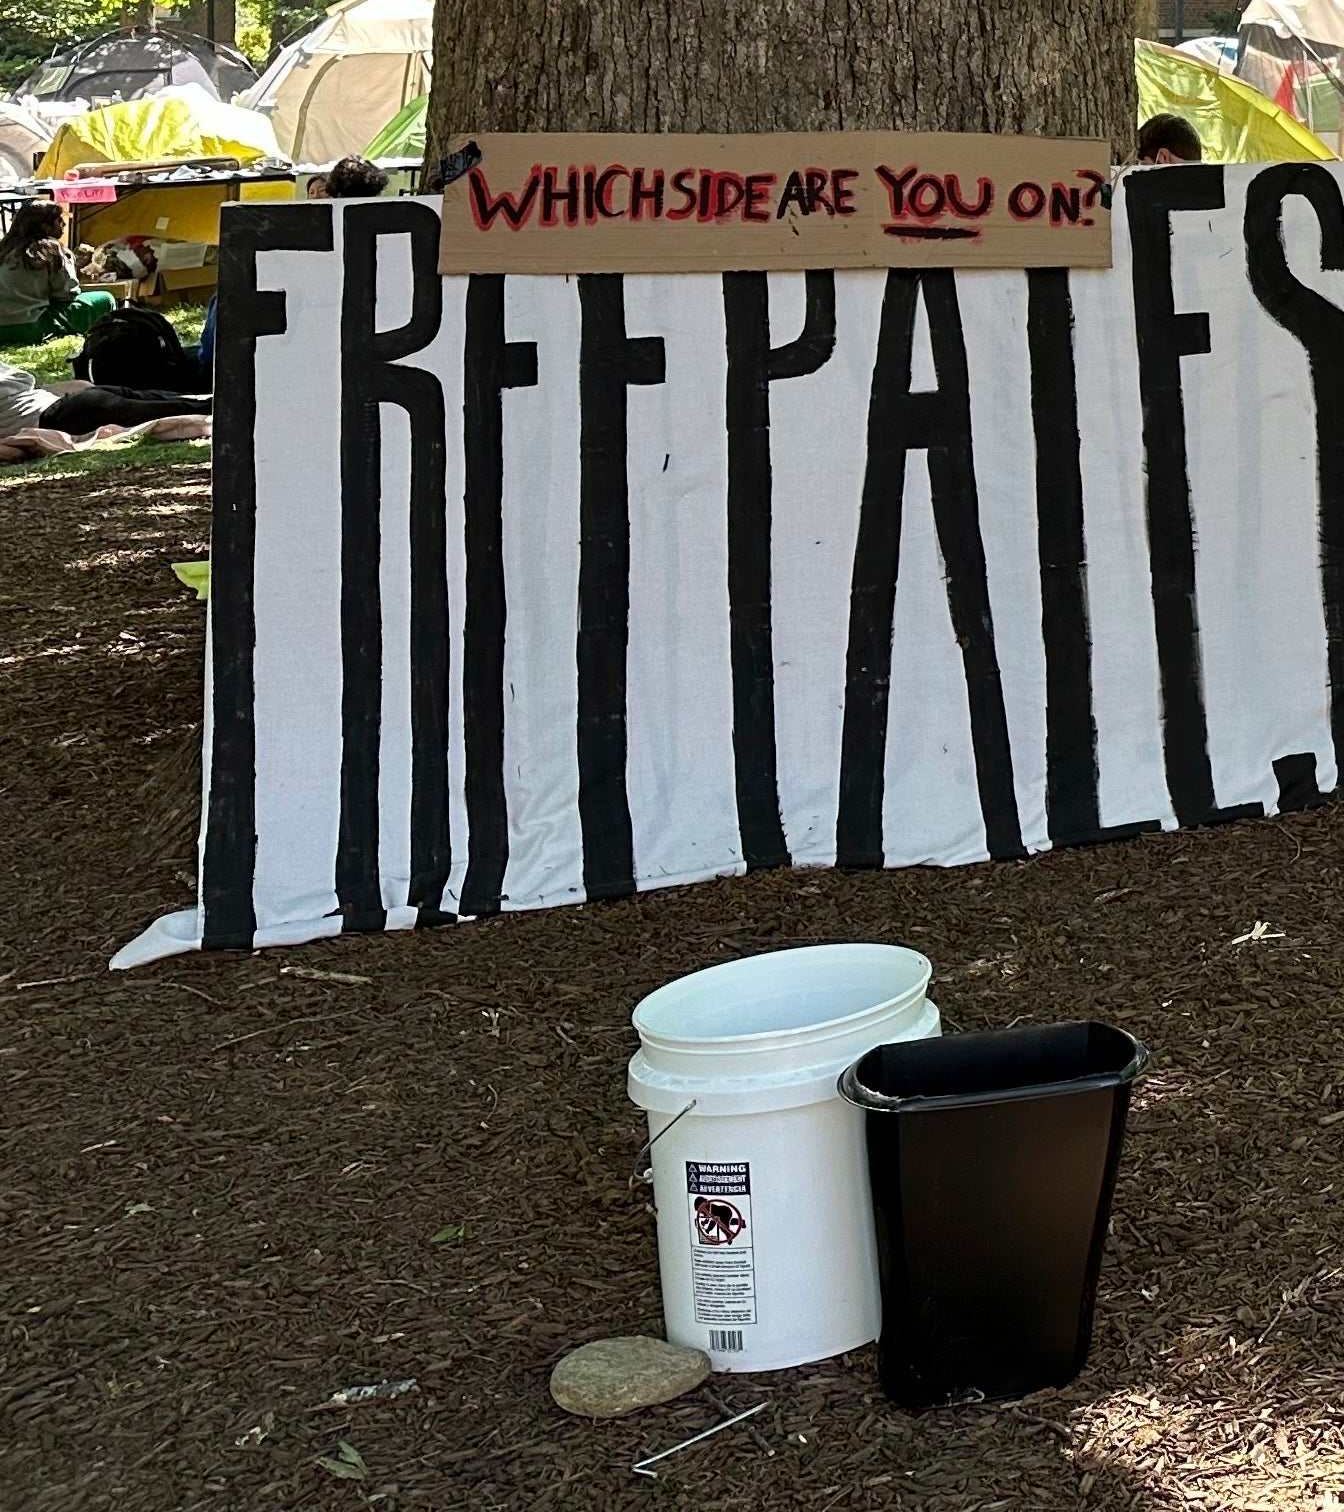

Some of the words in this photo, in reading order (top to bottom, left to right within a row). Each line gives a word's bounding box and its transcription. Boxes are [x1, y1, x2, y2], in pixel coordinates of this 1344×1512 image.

[467, 164, 665, 231] WHICH
[666, 168, 777, 224] SIDE
[777, 167, 859, 220] ARE
[875, 164, 995, 224] YOU
[1008, 169, 1106, 228] ON?
[203, 201, 666, 950] FREE
[698, 1164, 747, 1173] WARNING
